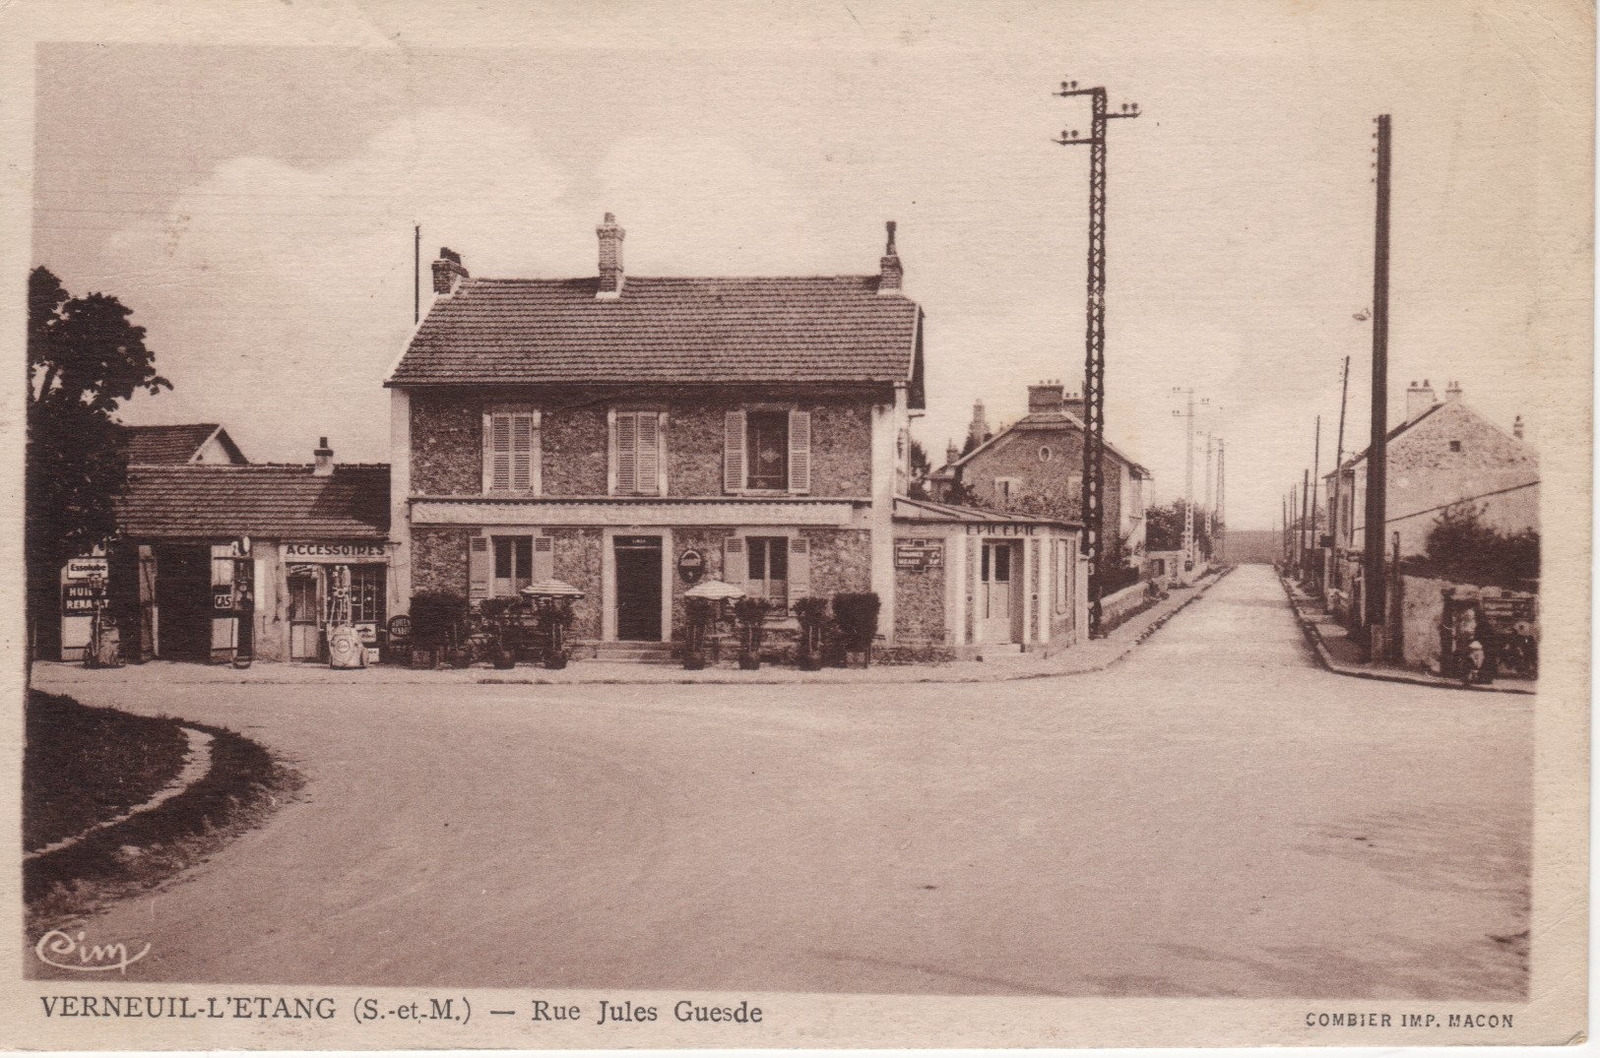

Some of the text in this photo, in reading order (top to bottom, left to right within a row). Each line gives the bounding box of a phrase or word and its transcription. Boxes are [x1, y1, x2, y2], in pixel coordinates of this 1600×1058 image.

[286, 544, 386, 556] ACCESSOIRES
[70, 563, 107, 572] Essolube
[69, 586, 107, 597] HUILS
